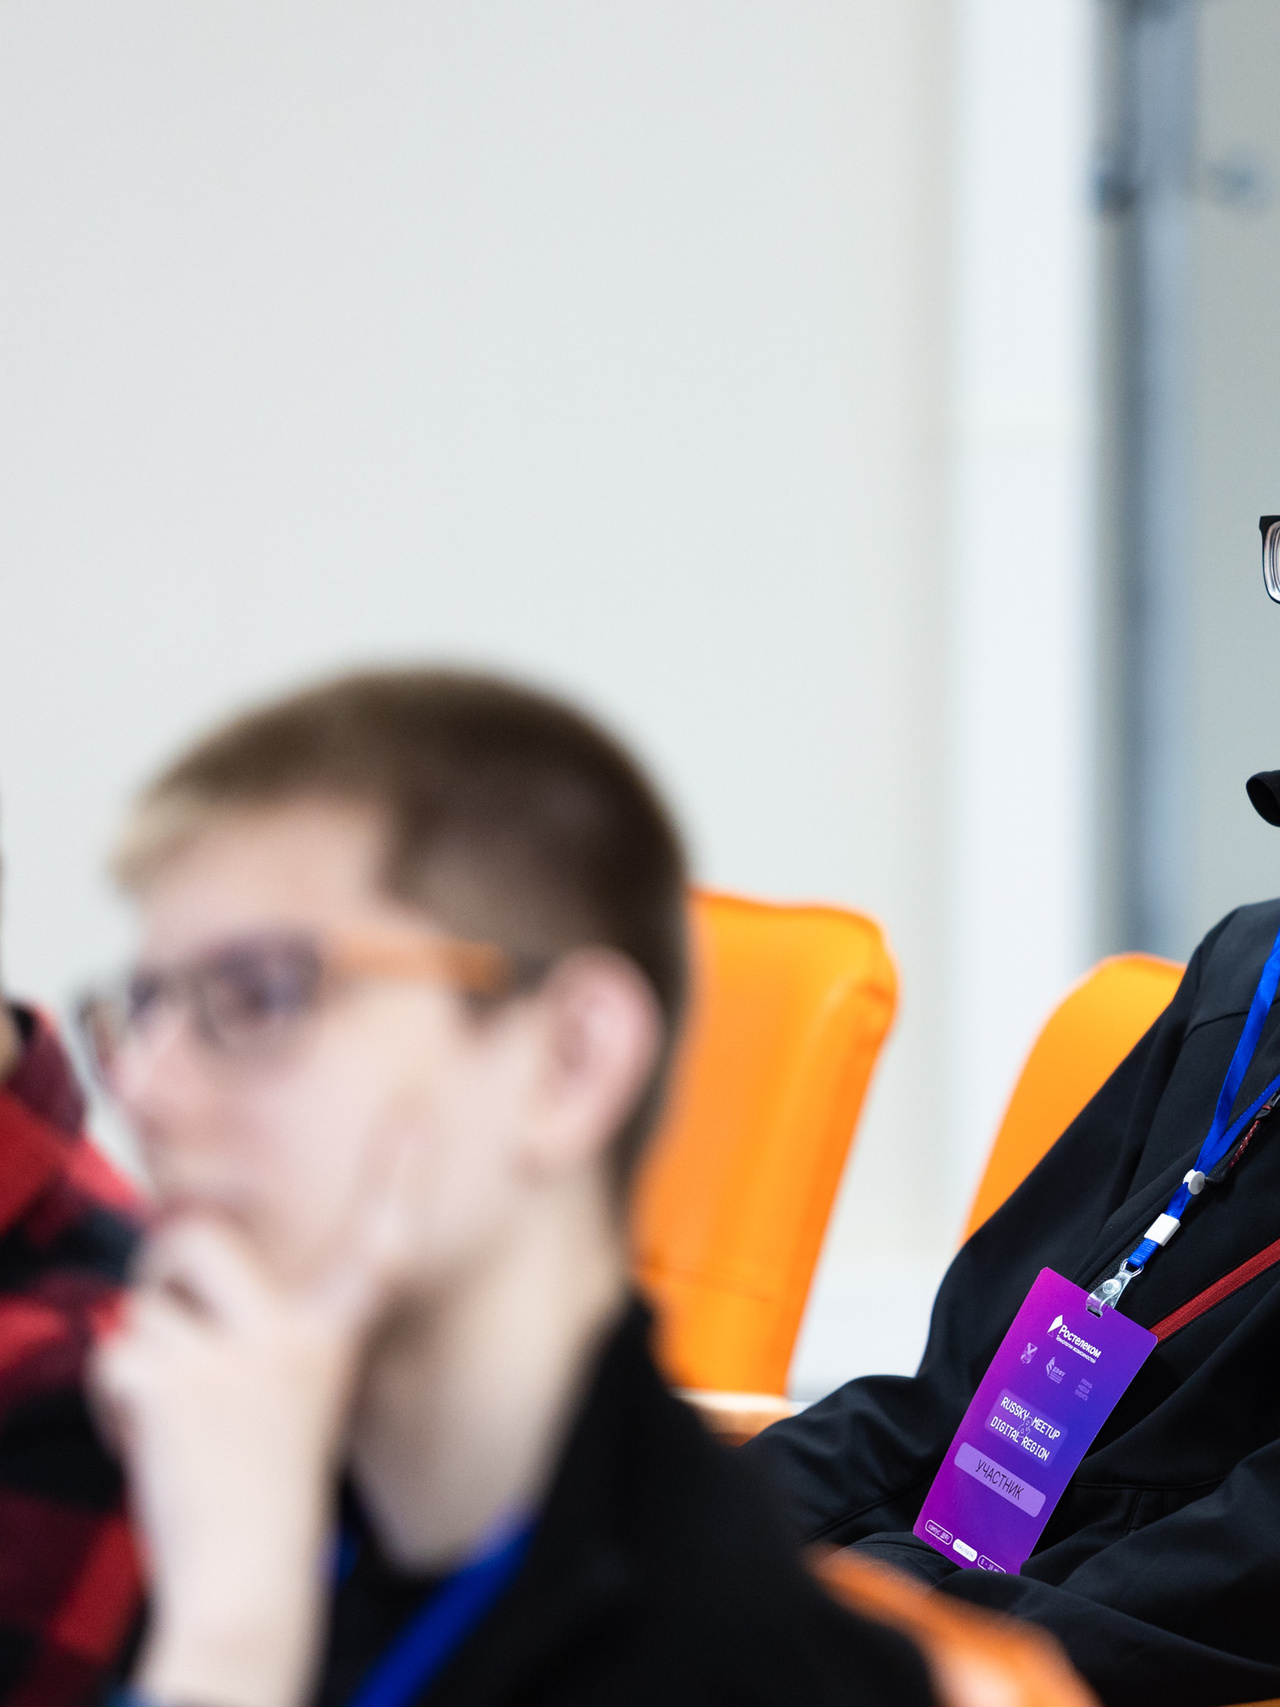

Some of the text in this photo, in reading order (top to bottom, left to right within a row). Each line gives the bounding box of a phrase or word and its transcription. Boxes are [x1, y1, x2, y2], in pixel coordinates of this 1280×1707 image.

[1058, 1324, 1102, 1359] Ростелеком
[990, 1416, 1051, 1462] DIGITAL REGION
[1000, 1396, 1061, 1440] RUSSKY MEETUP
[975, 1459, 1025, 1500] УЧАСТНИК
